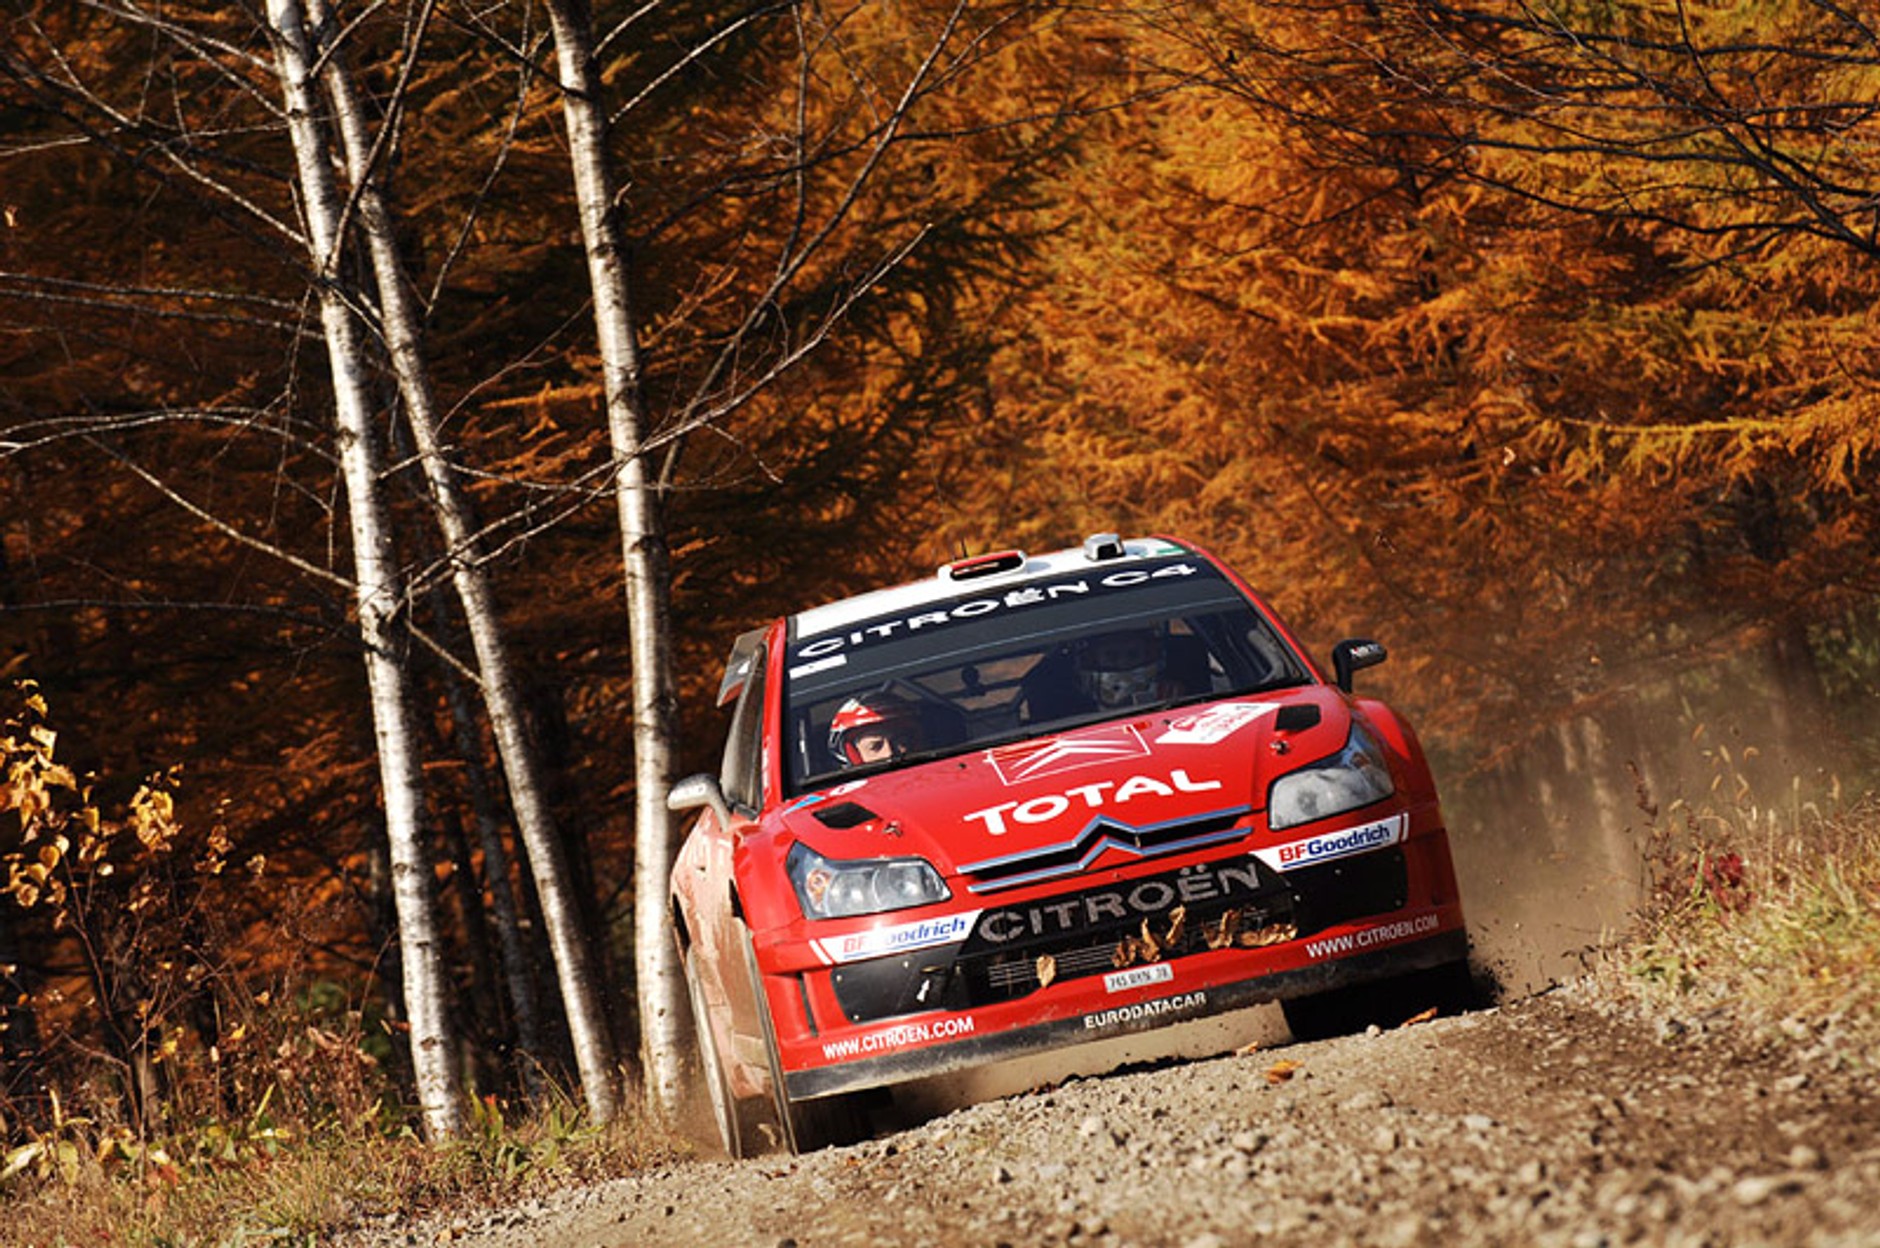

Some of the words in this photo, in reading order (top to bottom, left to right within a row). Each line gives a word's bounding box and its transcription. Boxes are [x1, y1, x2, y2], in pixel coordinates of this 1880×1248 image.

[1101, 563, 1198, 587] C4
[963, 769, 1222, 836] TOTAL
[1278, 824, 1391, 863] BFGoodrich
[978, 863, 1262, 942] CITROËN
[843, 917, 966, 953] BFoodrich
[1305, 914, 1440, 959] WWW.CITROEN.COM
[1083, 991, 1207, 1029] EURODATACAR
[822, 1015, 975, 1060] WWW.CITROEN.COM
